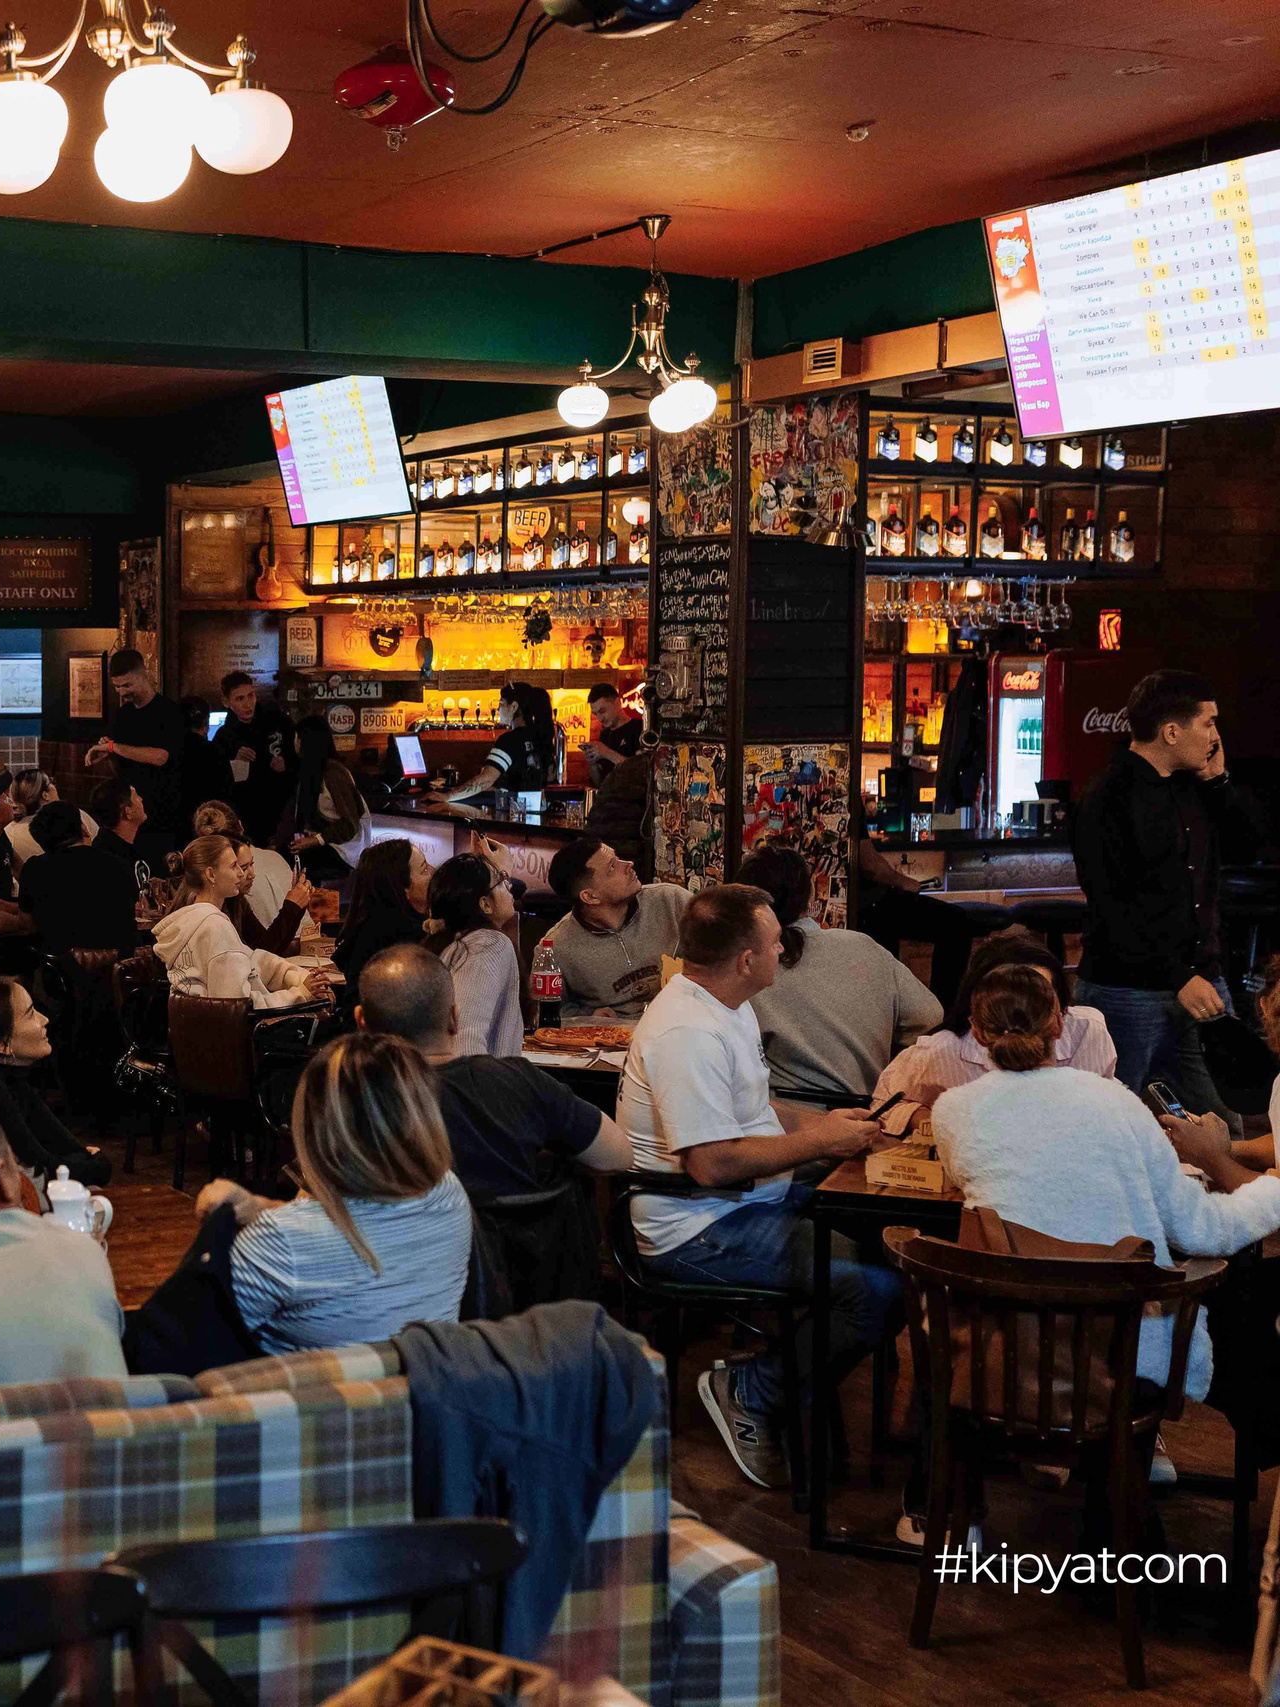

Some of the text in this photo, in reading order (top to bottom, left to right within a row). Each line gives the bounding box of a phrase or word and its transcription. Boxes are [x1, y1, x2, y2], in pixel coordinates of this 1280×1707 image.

[1076, 252, 1100, 262] Zombies
[1021, 400, 1050, 410] Наш Бар
[514, 510, 546, 528] BEER
[24, 559, 52, 568] ВХОД
[9, 570, 65, 578] ЗАПРЕЩЕН
[40, 587, 78, 598] ONLY
[289, 627, 313, 640] BEER
[290, 654, 314, 665] HERE!
[330, 714, 354, 724] NASH
[362, 714, 388, 727] 8908
[612, 964, 661, 993] CONVERSE
